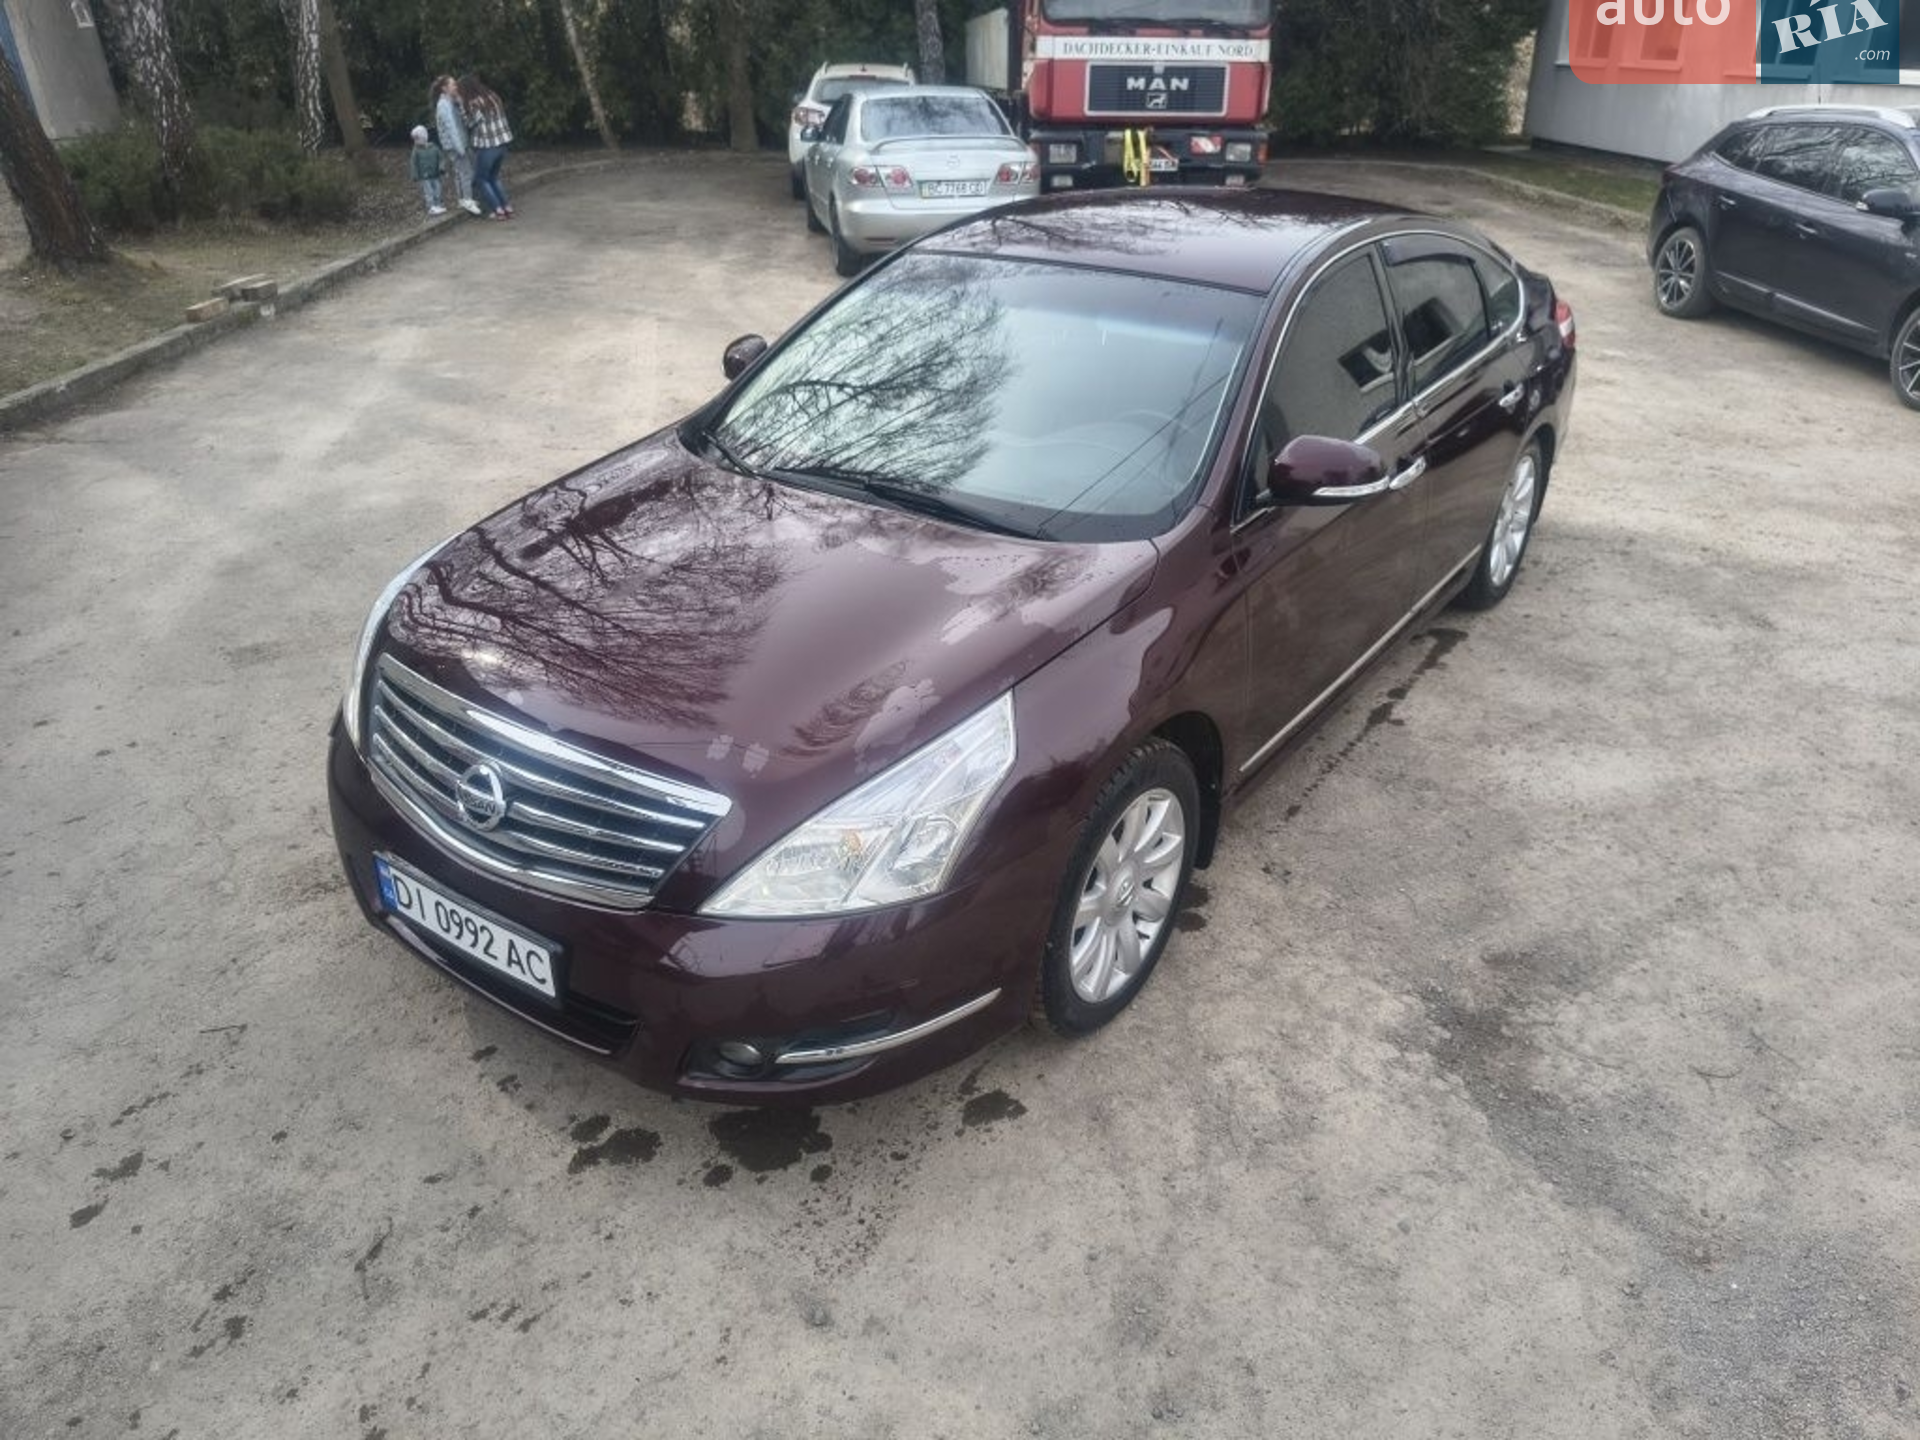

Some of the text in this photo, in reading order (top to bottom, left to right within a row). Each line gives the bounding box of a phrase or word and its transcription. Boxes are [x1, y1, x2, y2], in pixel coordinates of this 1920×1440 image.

[1218, 43, 1254, 57] NORD
[1126, 76, 1189, 91] MAN
[394, 874, 547, 985] DI 0992 AC
